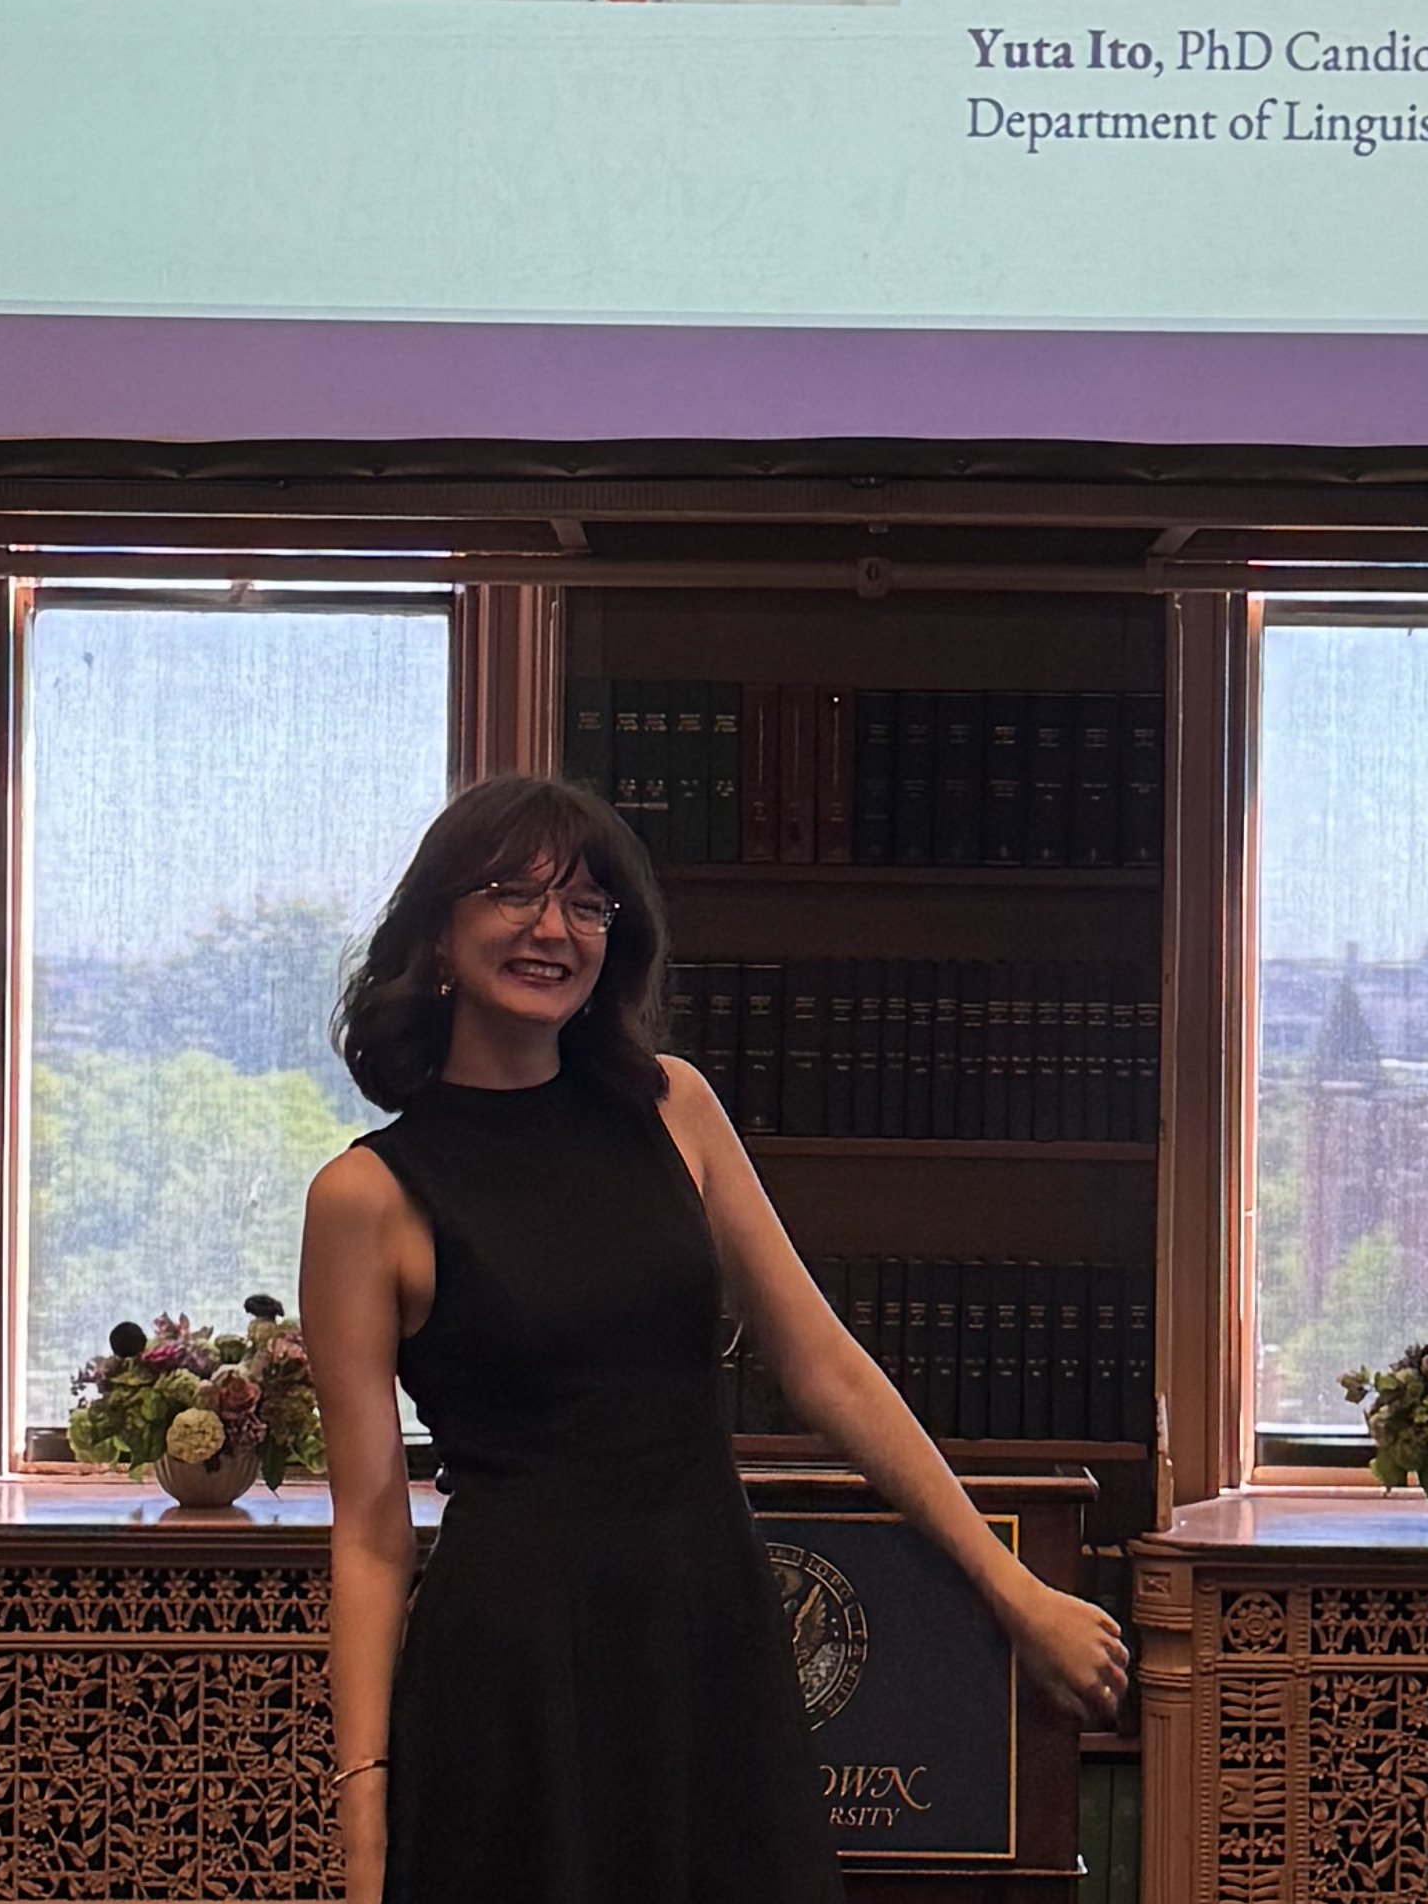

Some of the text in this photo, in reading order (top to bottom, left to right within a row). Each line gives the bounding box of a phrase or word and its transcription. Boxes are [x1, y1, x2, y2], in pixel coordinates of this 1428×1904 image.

[967, 28, 1075, 68] Yuta
[1086, 29, 1164, 78] Ito,
[1176, 28, 1272, 71] PhD
[967, 98, 1218, 154] Department
[1229, 98, 1278, 140] of
